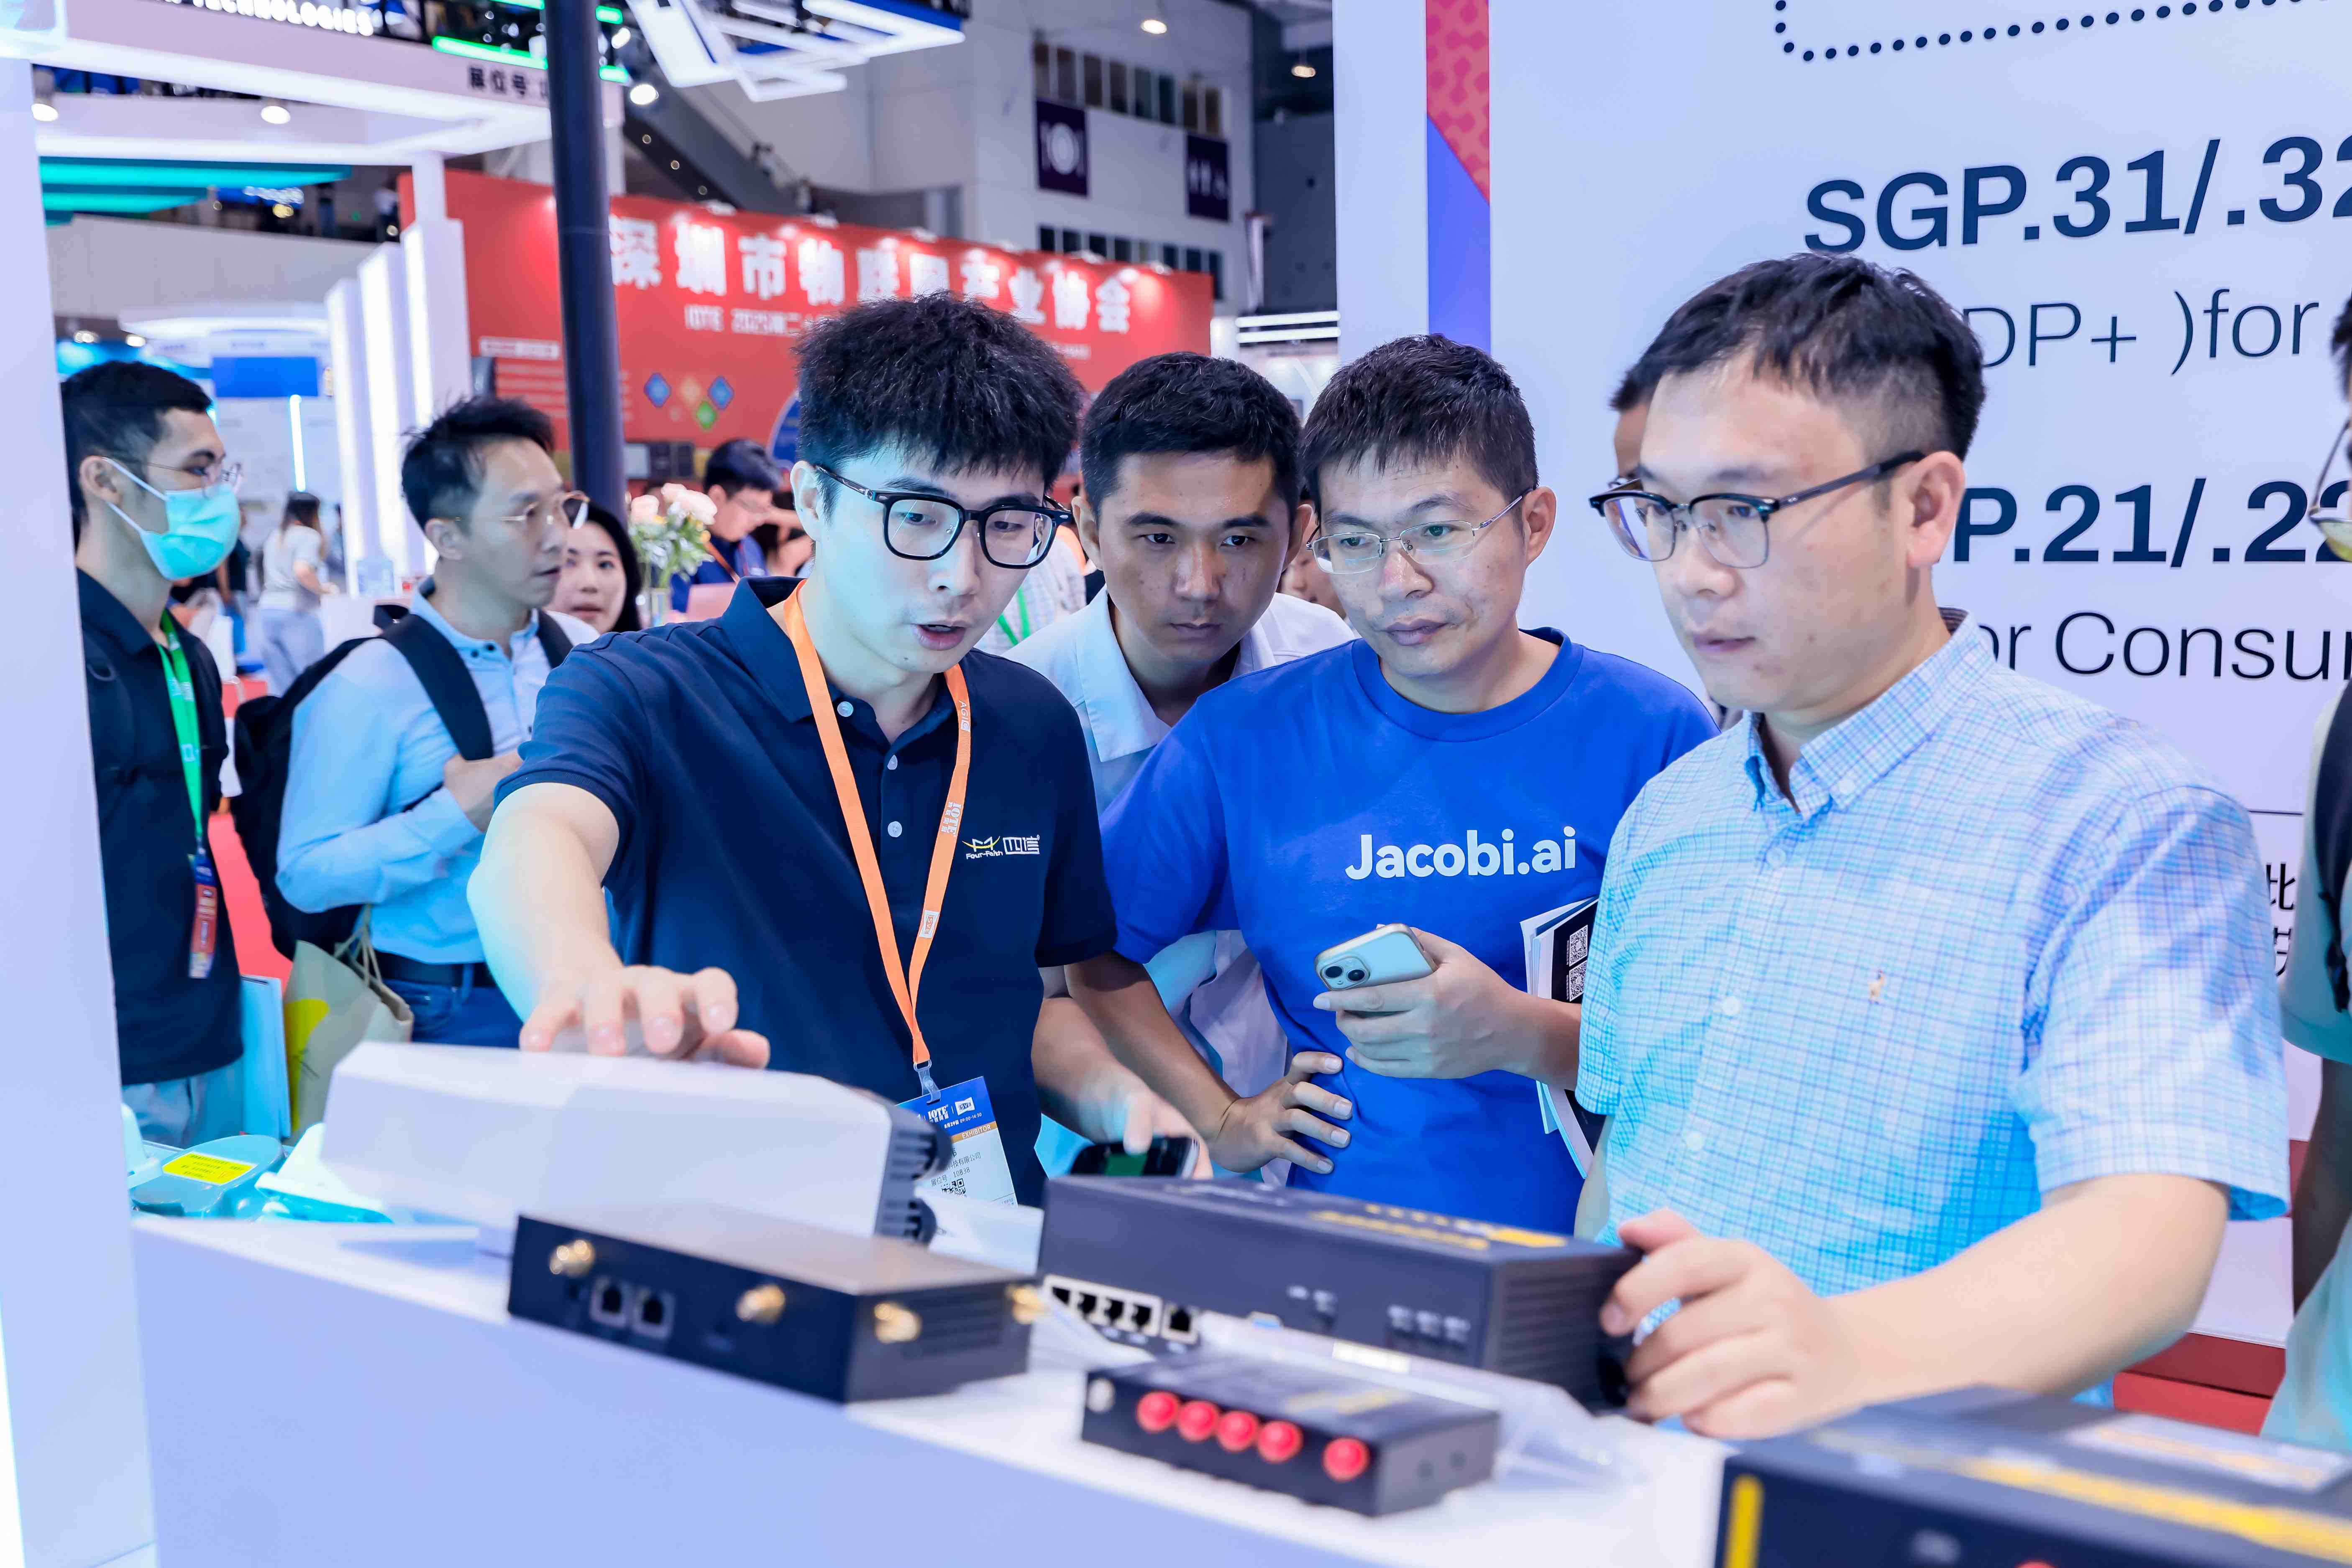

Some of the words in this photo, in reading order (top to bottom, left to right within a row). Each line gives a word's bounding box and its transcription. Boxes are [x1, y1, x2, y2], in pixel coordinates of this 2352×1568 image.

[2055, 611, 2352, 681] Consu
[966, 850, 1003, 860] Four-Faith
[1345, 826, 1576, 880] Jacobi.ai
[927, 1105, 948, 1120] IOTE
[962, 1125, 991, 1138] EXHIBITOR
